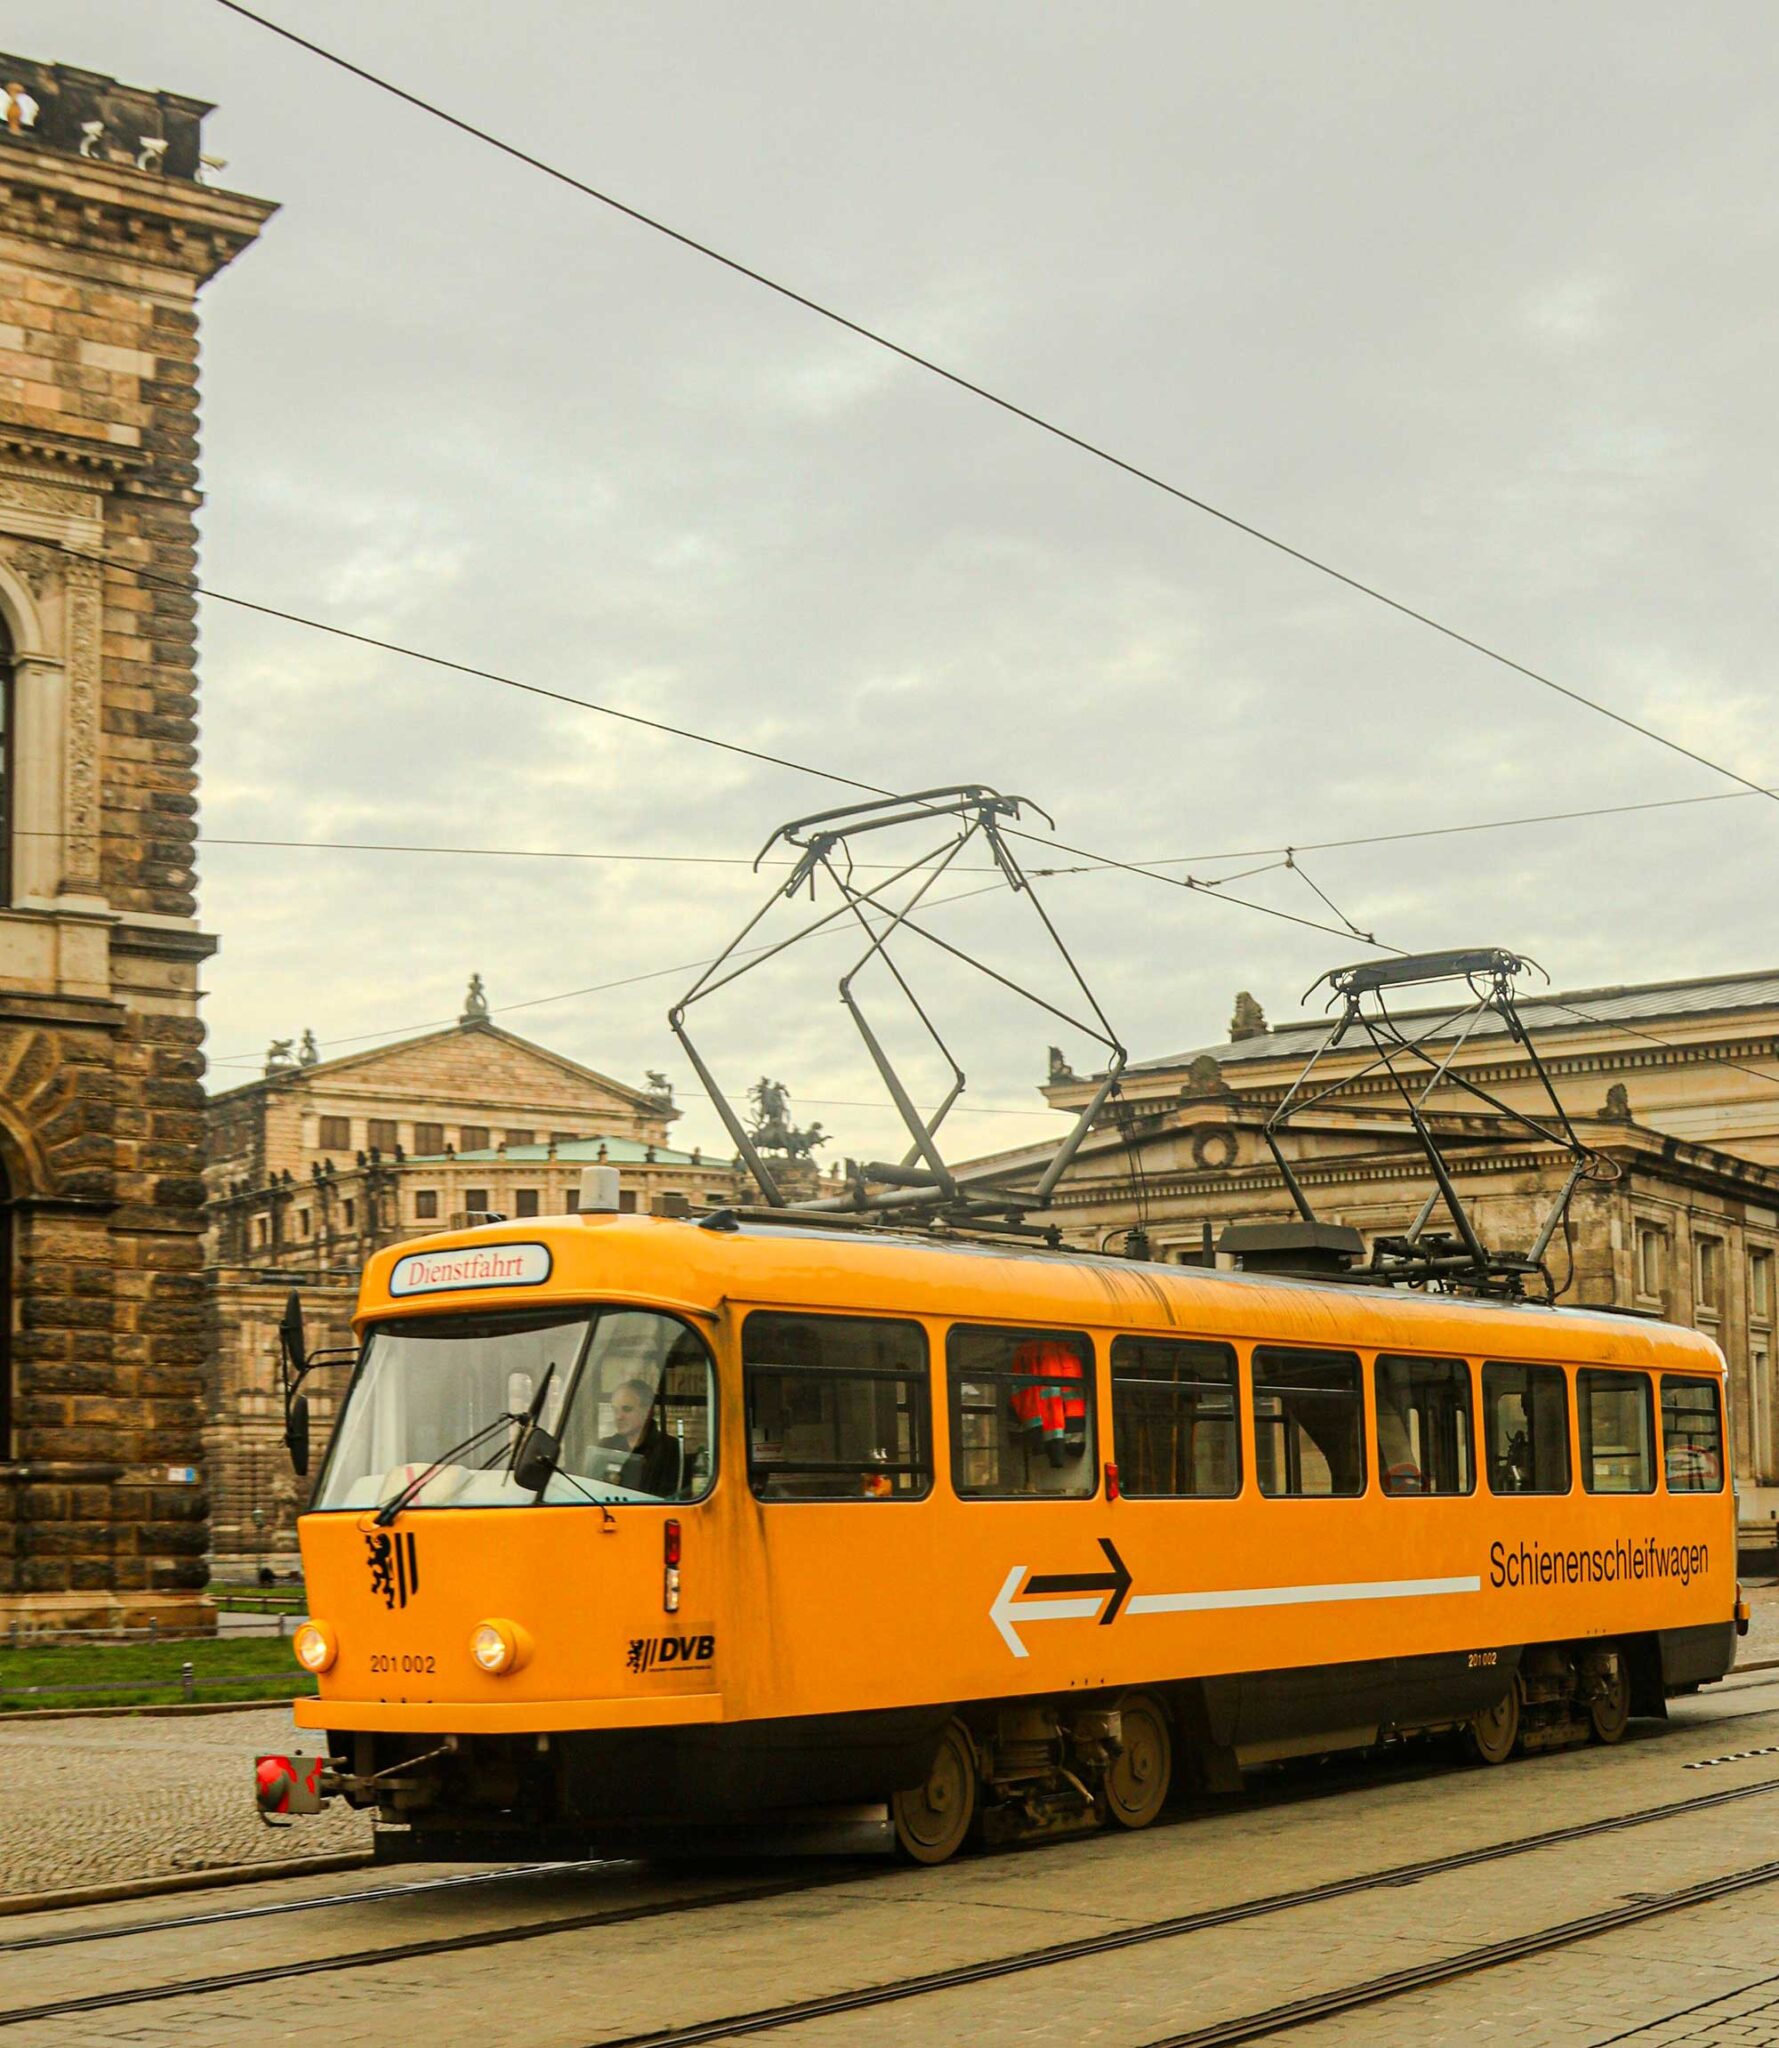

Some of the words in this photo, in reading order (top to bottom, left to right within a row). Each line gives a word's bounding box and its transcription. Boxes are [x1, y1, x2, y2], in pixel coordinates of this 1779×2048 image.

[409, 1253, 523, 1286] Dienstfahrt
[1490, 1537, 1708, 1588] Schienenschleifwagen
[658, 1635, 715, 1662] DVB
